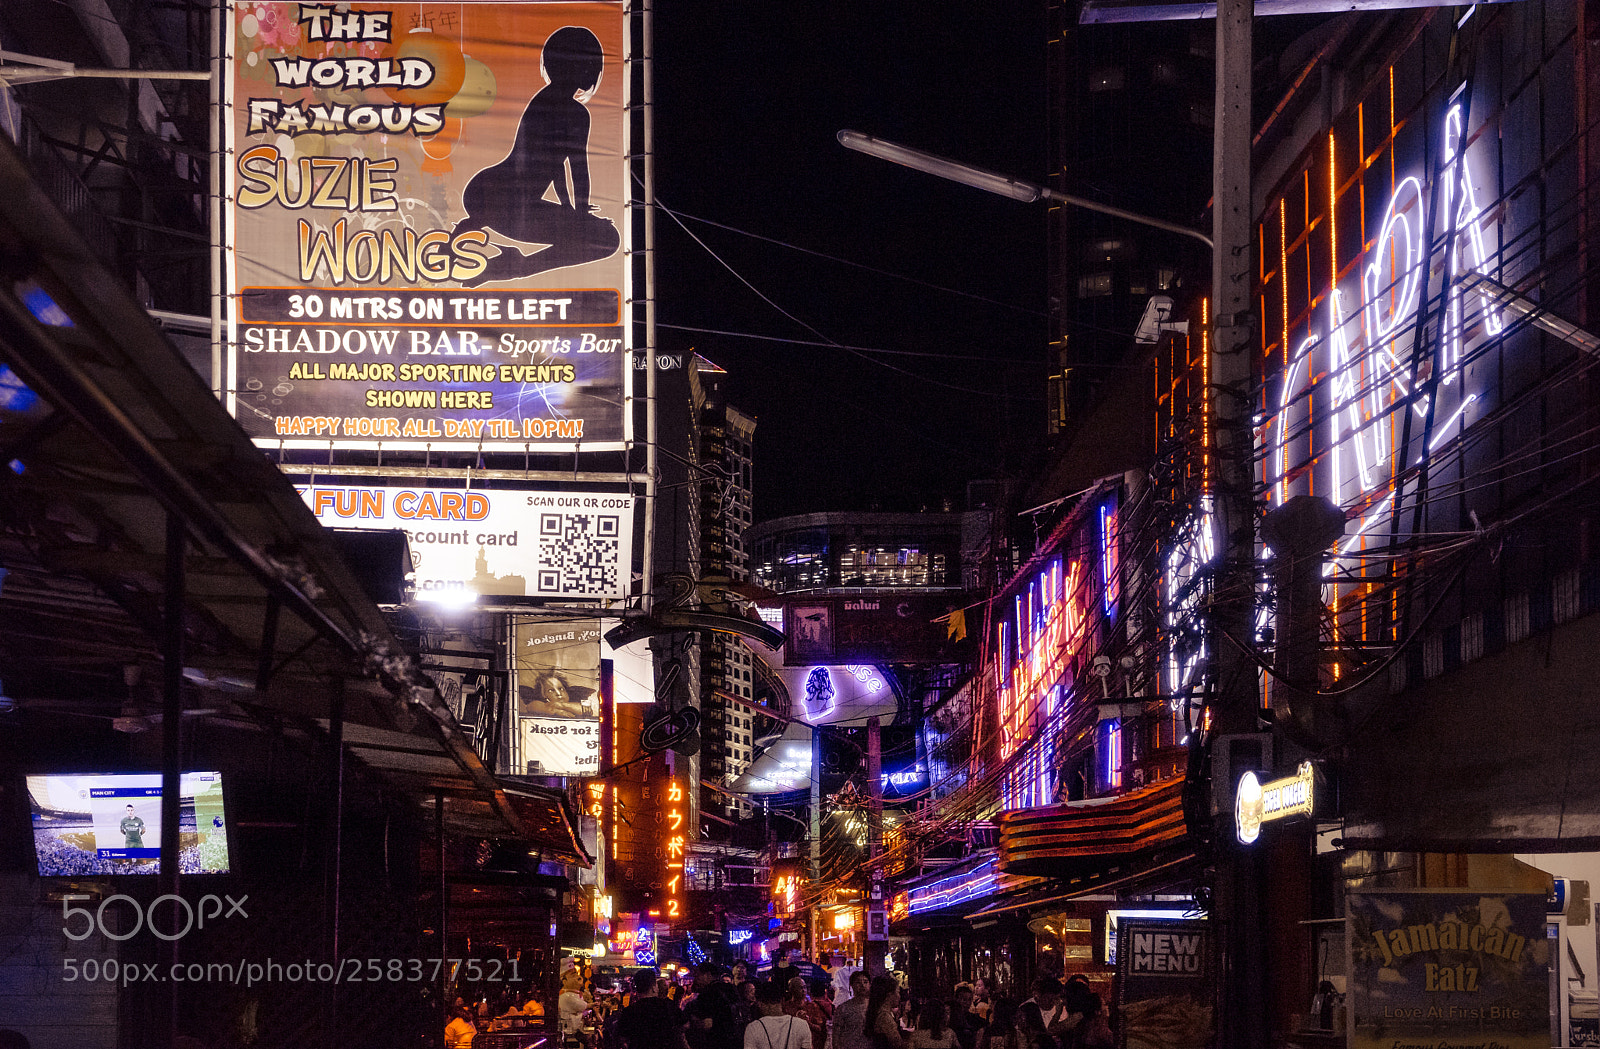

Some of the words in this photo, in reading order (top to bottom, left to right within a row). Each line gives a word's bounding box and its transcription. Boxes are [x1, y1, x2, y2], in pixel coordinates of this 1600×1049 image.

[300, 4, 392, 42] THE
[409, 10, 458, 32] 新年
[274, 58, 435, 88] WORLD
[247, 99, 447, 136] FAMOUS
[237, 145, 398, 212] SUZIE
[299, 217, 490, 285] WONGS
[288, 295, 324, 319] 30
[330, 297, 403, 320] MTRS
[409, 298, 443, 320] ON
[450, 298, 500, 320] THE
[507, 298, 571, 321] LEFT
[244, 328, 399, 354] SHADOW
[498, 334, 570, 357] Sports
[578, 334, 622, 354] Bar
[289, 363, 325, 381] ALL
[329, 363, 395, 382] MAJOR
[399, 364, 495, 383] SPORTING
[500, 364, 575, 383] EVENTS
[365, 390, 436, 409] SHOWN
[441, 391, 493, 410] HERE
[276, 416, 339, 437] HAPPY
[343, 417, 400, 437] HOUR
[403, 418, 440, 437] ALL
[446, 419, 486, 438] DAY
[488, 419, 520, 438] TIL
[314, 489, 384, 518] FUN
[393, 490, 490, 521] CARD
[527, 495, 555, 508] SCAN
[557, 495, 581, 509] OUR
[583, 497, 600, 509] QR
[601, 497, 631, 510] CODE
[476, 531, 518, 547] card
[1134, 933, 1198, 955] NEW
[1371, 920, 1527, 967] Jamaican
[1134, 954, 1198, 972] MENU
[1425, 963, 1479, 993] Eatz
[1384, 1005, 1422, 1020] Love
[1426, 1005, 1443, 1020] At
[1450, 1005, 1485, 1020] First
[1491, 1005, 1522, 1020] Bite
